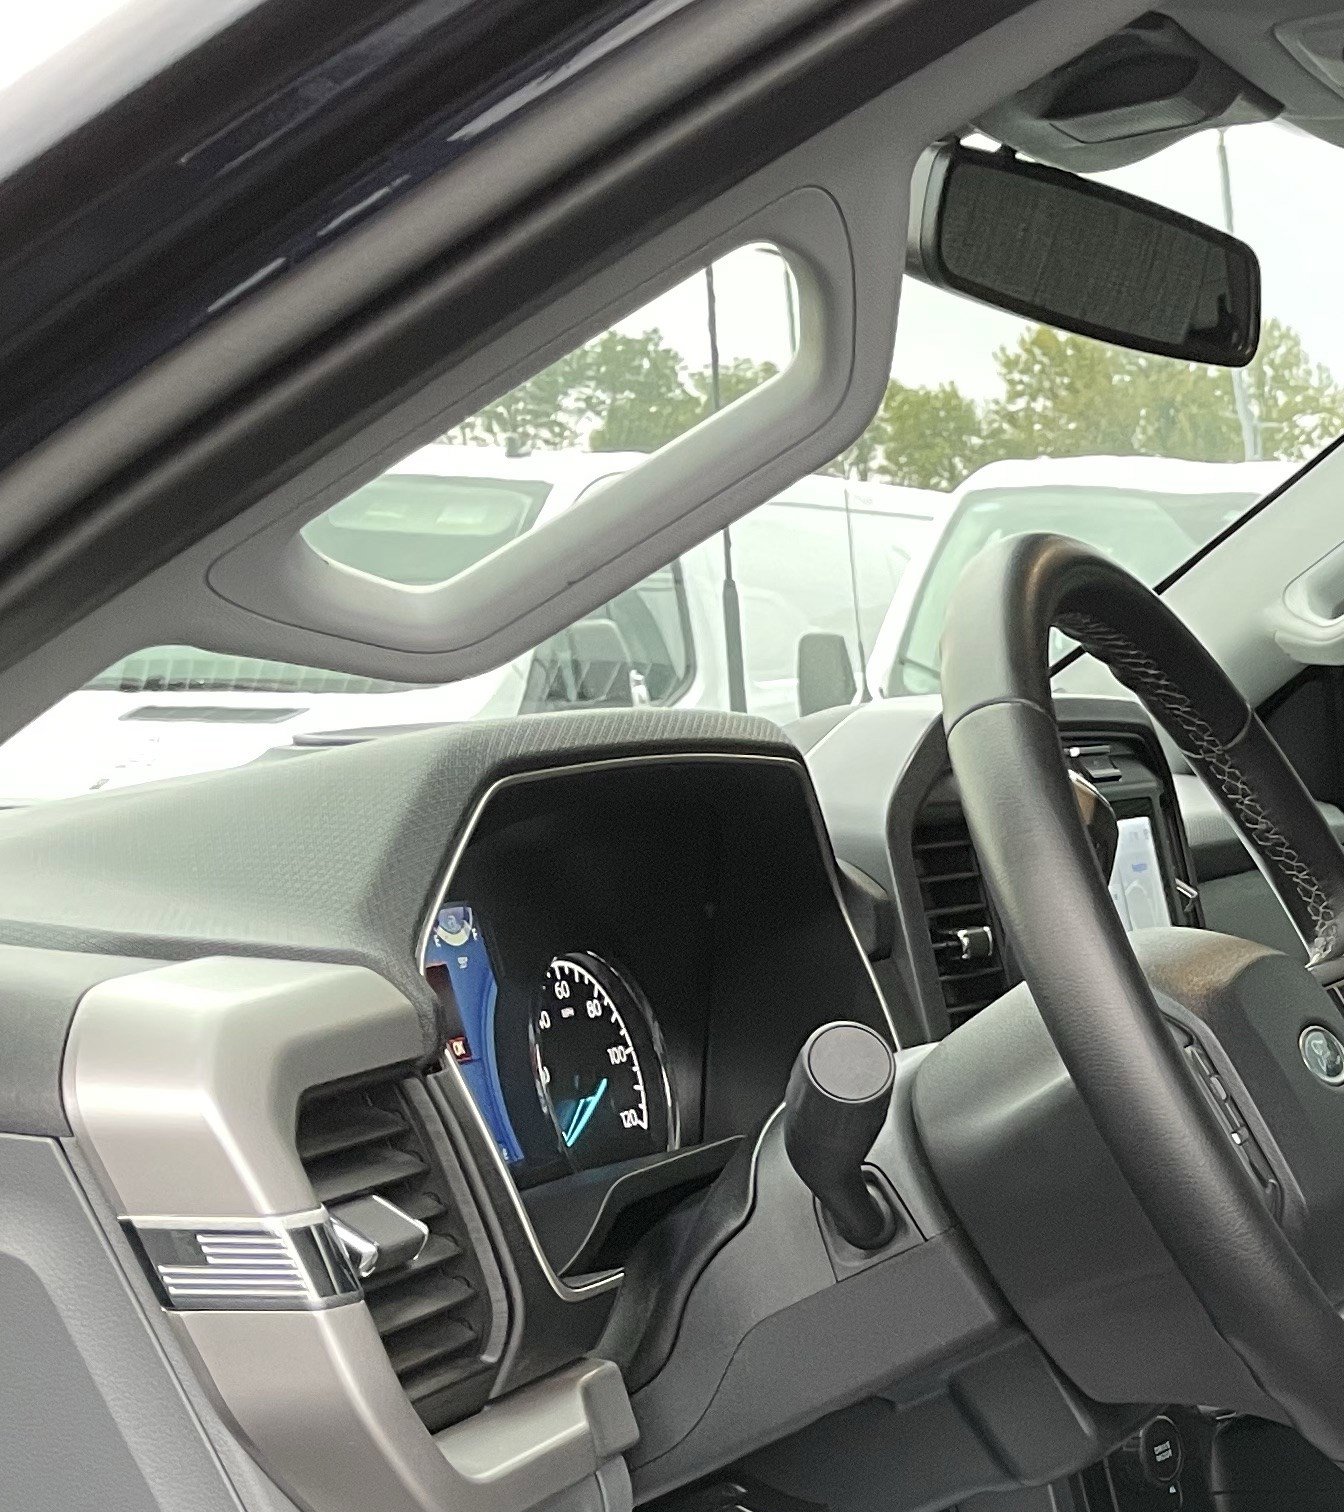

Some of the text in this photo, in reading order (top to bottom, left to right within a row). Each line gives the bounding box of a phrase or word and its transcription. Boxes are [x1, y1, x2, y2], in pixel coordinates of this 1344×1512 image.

[554, 980, 570, 1000] 60
[586, 999, 602, 1018] 80
[607, 1045, 627, 1065] 100
[620, 1109, 638, 1128] 120
